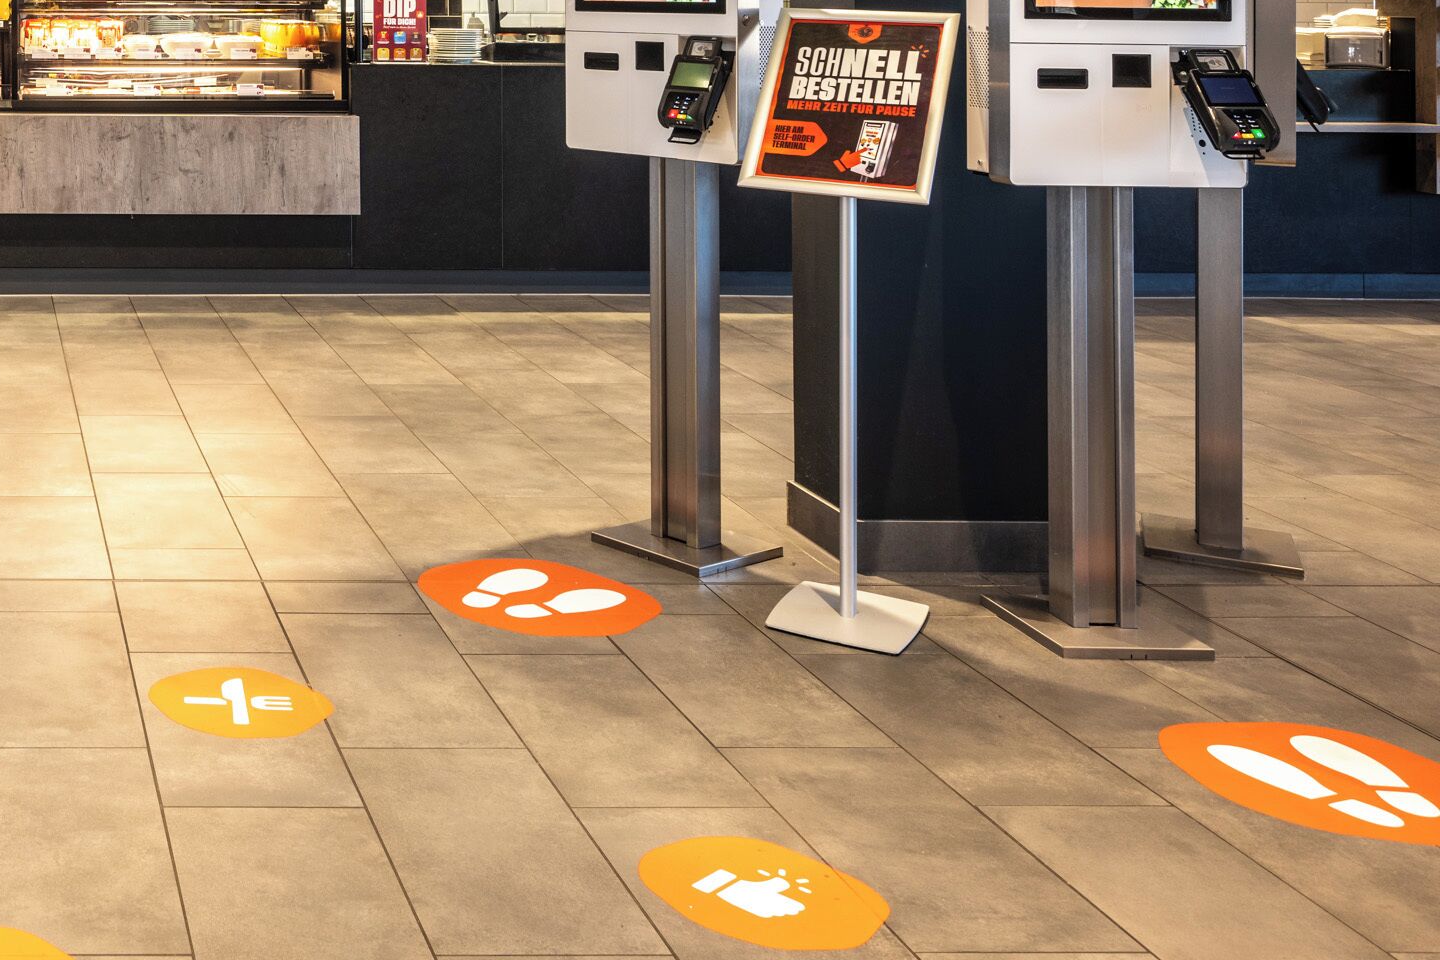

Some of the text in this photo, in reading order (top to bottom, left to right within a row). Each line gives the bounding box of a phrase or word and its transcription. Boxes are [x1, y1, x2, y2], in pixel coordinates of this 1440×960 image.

[794, 46, 922, 81] SCHNELL
[789, 76, 921, 106] BESTELLEN
[787, 100, 821, 111] MEHR
[823, 102, 848, 113] ZEIT
[878, 105, 917, 117] PAUSE
[775, 124, 804, 134] HIER AM
[773, 132, 815, 143] SELF-ORDER
[772, 140, 807, 150] TERMINAL
